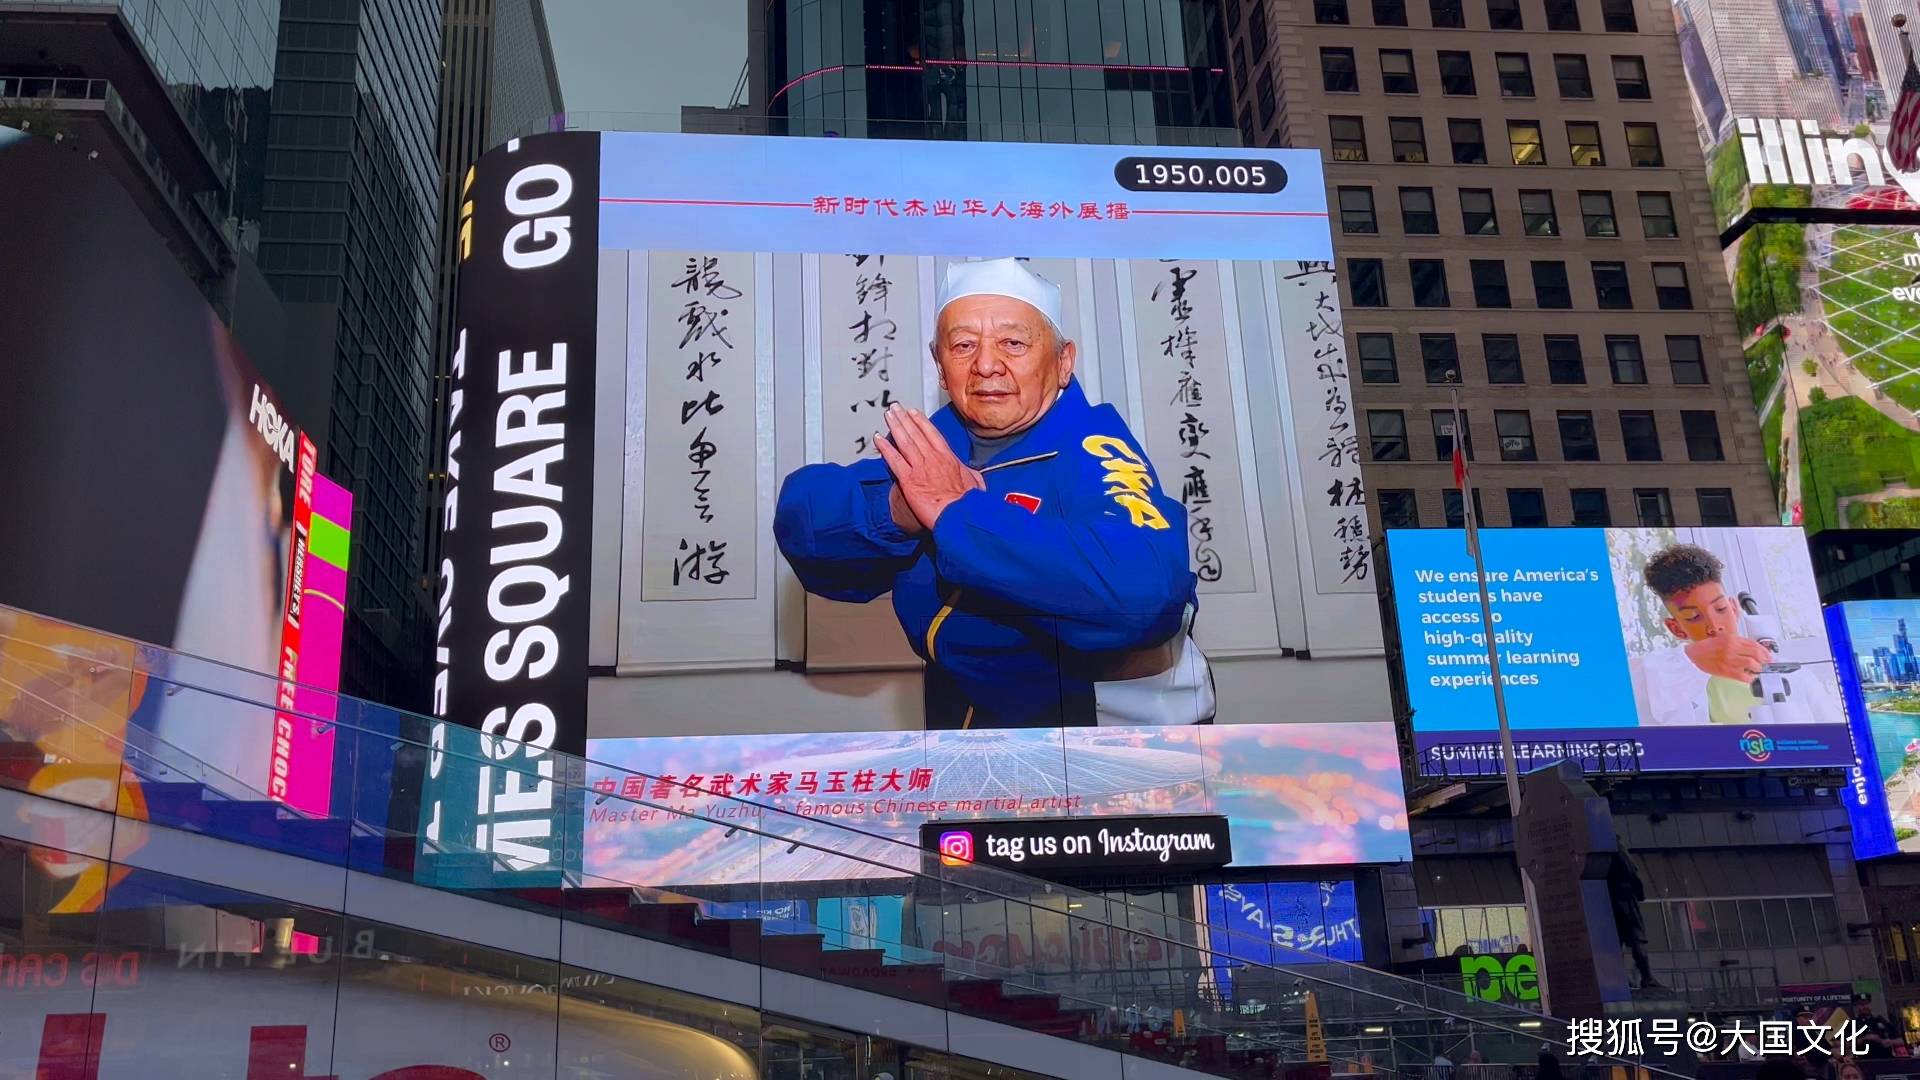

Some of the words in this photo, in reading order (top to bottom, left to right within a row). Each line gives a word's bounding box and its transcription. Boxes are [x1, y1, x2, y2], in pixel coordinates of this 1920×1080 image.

[1135, 163, 1266, 187] 1950.005
[502, 163, 573, 270] GO
[812, 195, 1131, 221] 新时代杰出华人海外展播
[249, 383, 295, 475] HOKA
[484, 342, 569, 682] SQUARE
[1415, 569, 1445, 583] We
[1513, 567, 1600, 583] America's
[1418, 588, 1497, 604] studens
[1501, 588, 1544, 603] have
[1421, 611, 1480, 625] access
[1486, 608, 1503, 624] o
[1506, 649, 1580, 667] learning
[280, 645, 299, 712] FREE
[592, 767, 934, 800] 中国著名武术家马玉柱大师
[589, 806, 660, 825] Master
[795, 800, 866, 818] famous
[874, 797, 949, 815] Chinese
[955, 794, 1024, 813] martial
[1030, 793, 1082, 811] artist
[986, 833, 1025, 863] tag
[1030, 836, 1058, 856] us
[1063, 834, 1092, 855] on
[1098, 827, 1216, 863] Instagram
